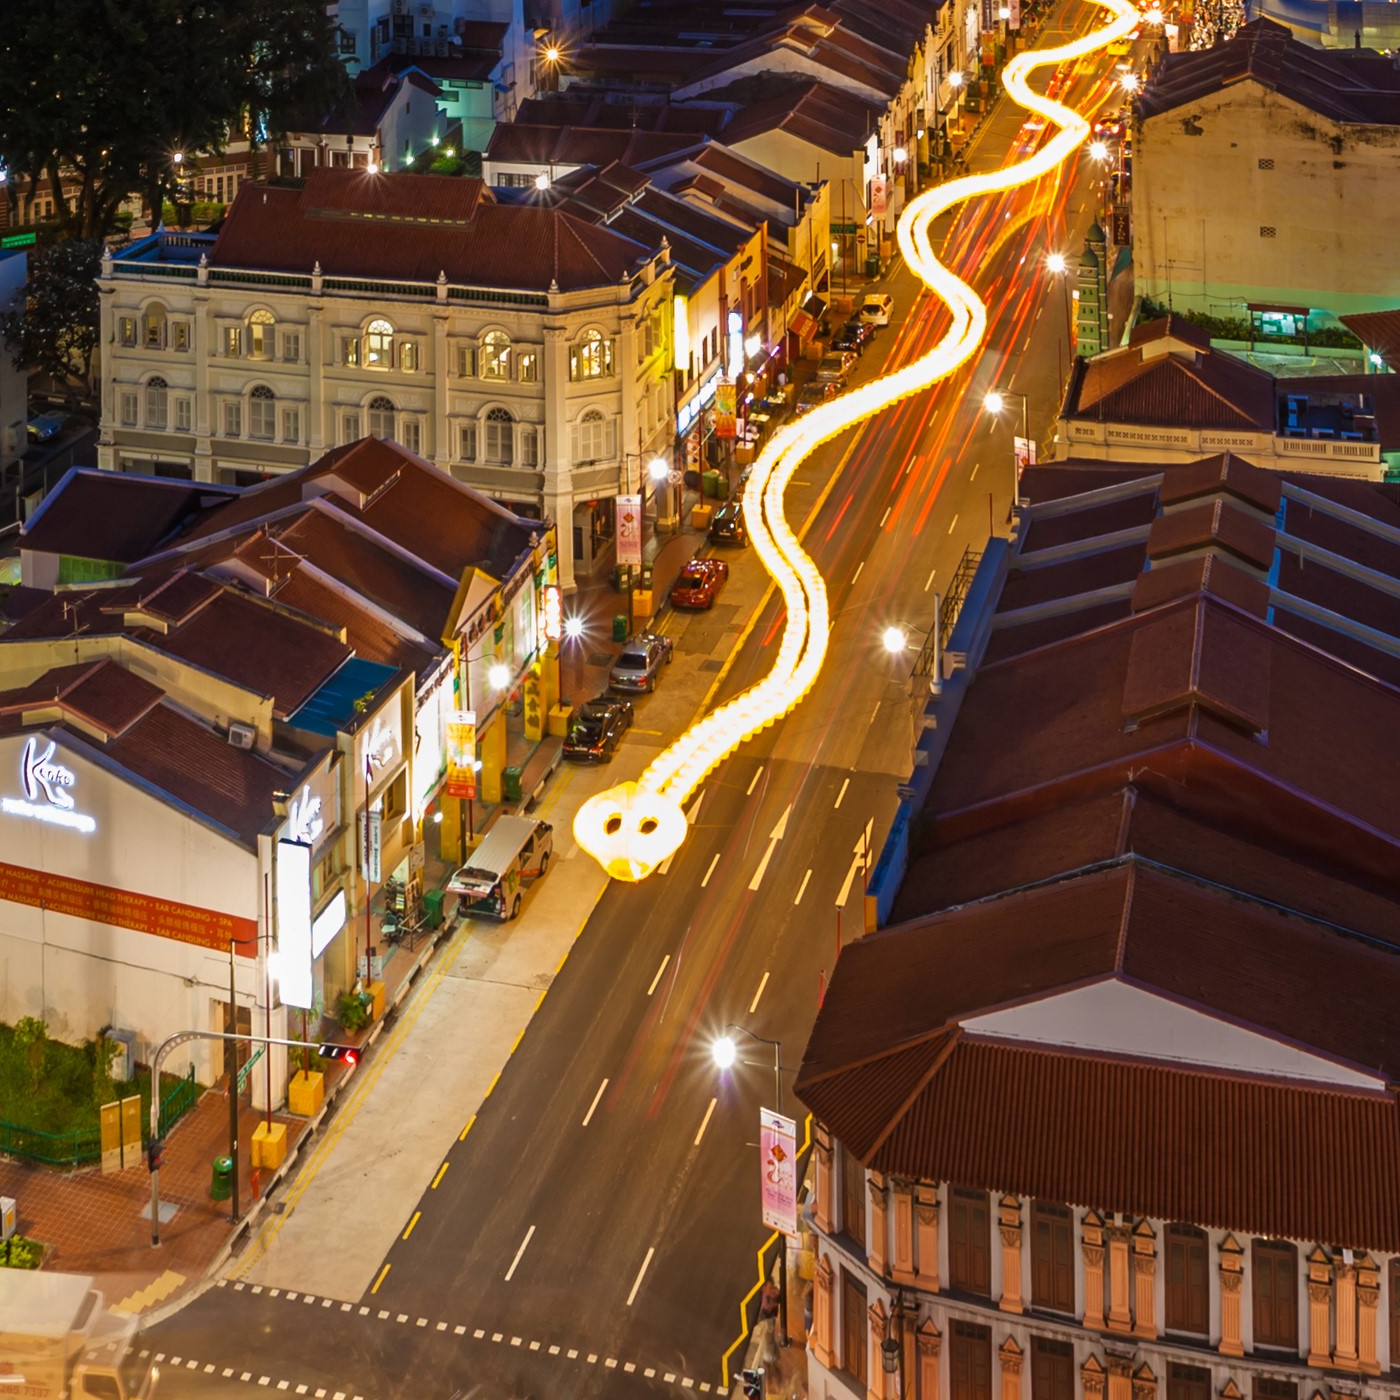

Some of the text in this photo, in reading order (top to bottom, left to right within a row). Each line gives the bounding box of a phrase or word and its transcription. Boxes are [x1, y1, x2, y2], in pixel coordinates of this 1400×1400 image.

[5, 868, 40, 884] MASSAGE
[47, 879, 95, 896] ACUPRESSURE
[95, 888, 116, 900] HEAD
[116, 893, 148, 907] THERAPY
[155, 902, 171, 913] EAR
[170, 905, 211, 923] CANDLING
[219, 917, 233, 927] SPA
[7, 891, 41, 906] MASSAGE
[48, 902, 96, 920] ACUPRESSURE
[96, 912, 117, 924] HEAD
[117, 917, 149, 932] THERAPY
[156, 927, 171, 936] EAR
[171, 930, 211, 947] CANDLING
